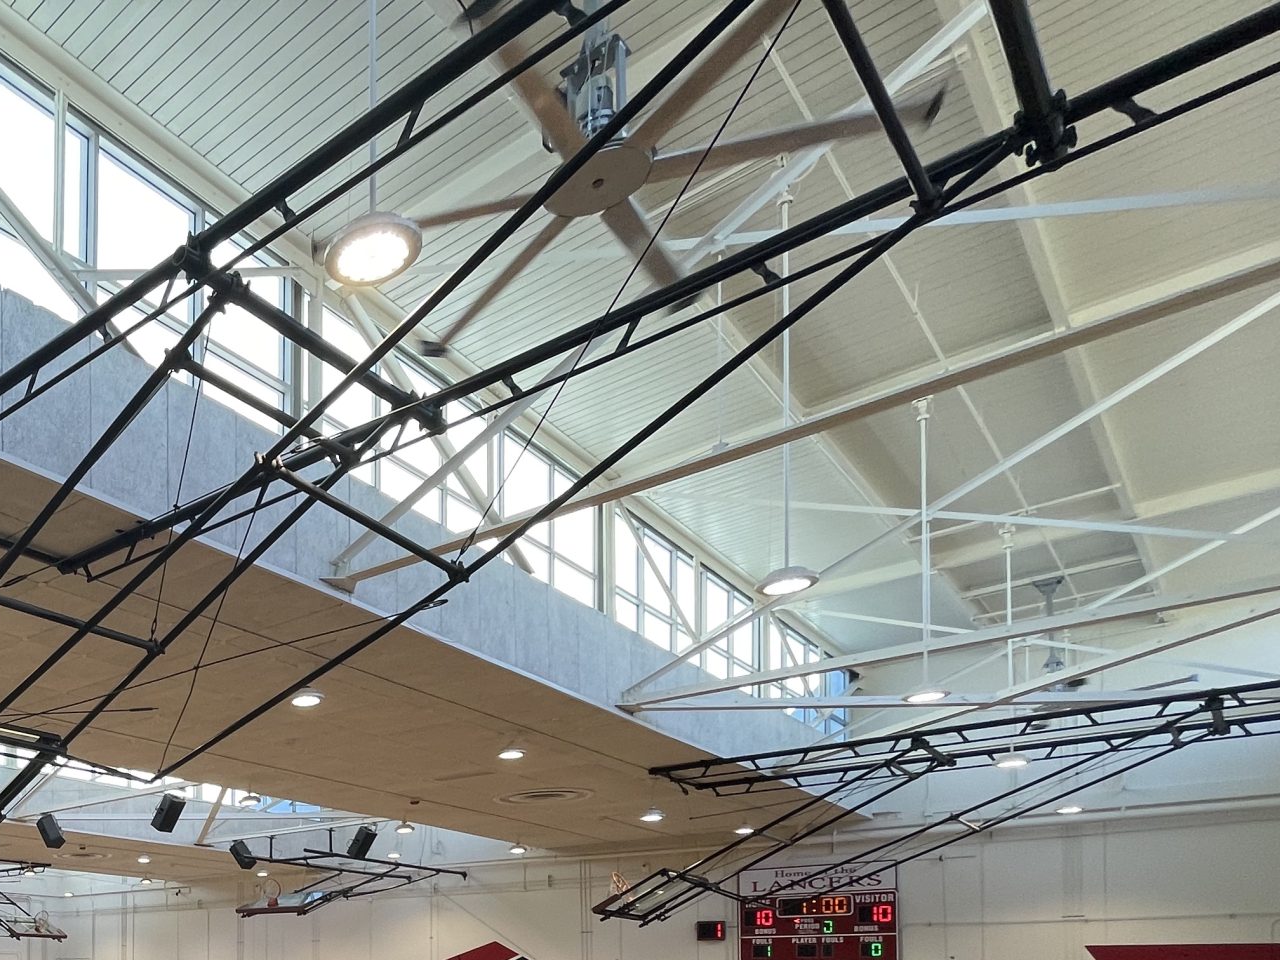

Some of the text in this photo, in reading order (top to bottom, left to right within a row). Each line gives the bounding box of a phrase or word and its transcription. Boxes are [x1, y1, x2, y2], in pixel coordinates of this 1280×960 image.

[802, 897, 847, 914] 1:00
[854, 893, 894, 903] VISITOR
[756, 910, 773, 926] 10
[872, 905, 892, 922] 10
